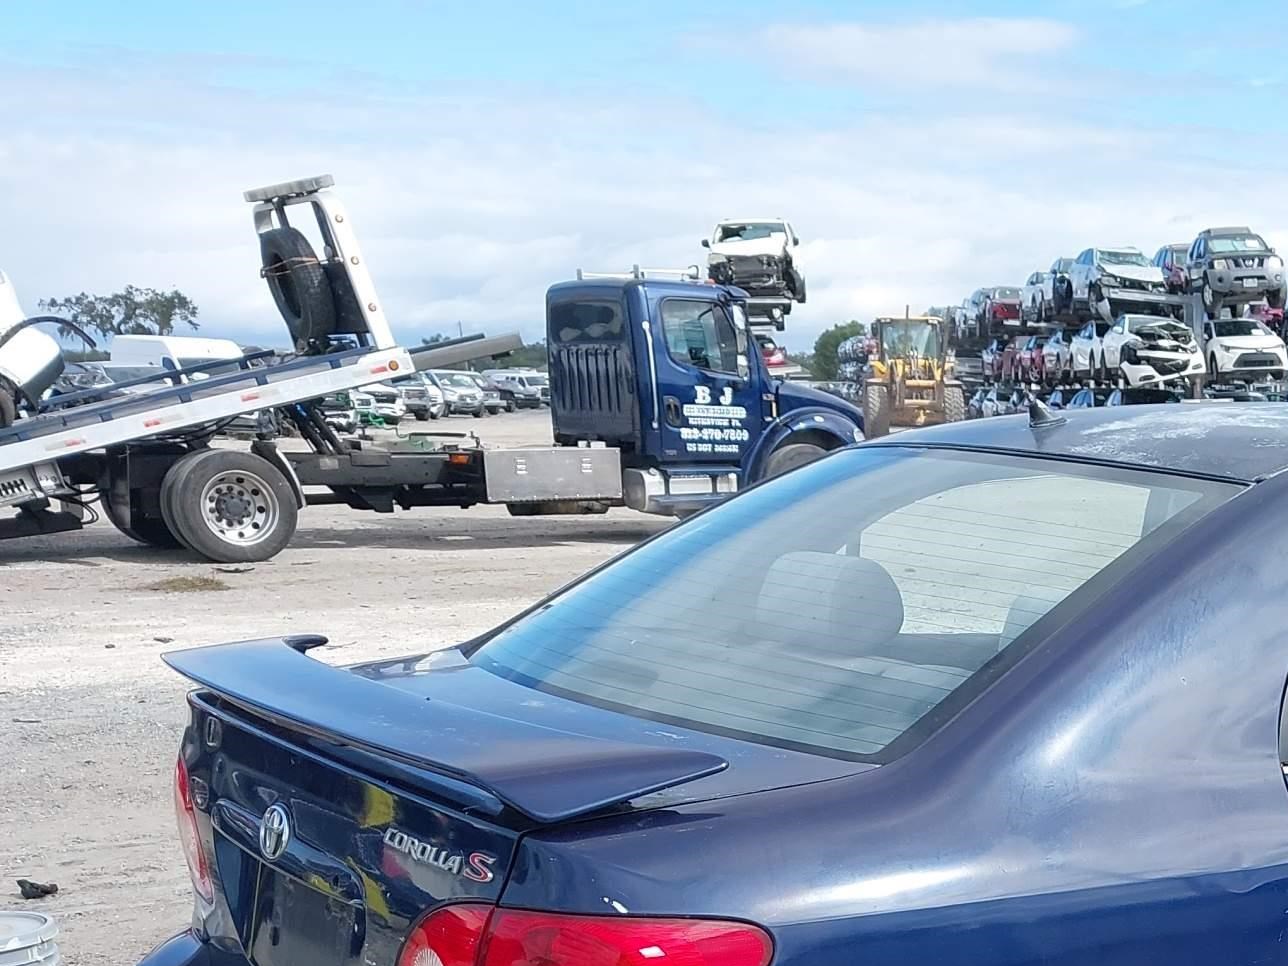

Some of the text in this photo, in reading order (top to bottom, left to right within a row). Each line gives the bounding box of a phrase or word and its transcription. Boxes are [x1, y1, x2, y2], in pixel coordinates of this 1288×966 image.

[694, 385, 733, 405] B J
[383, 827, 496, 883] COROLLA S
